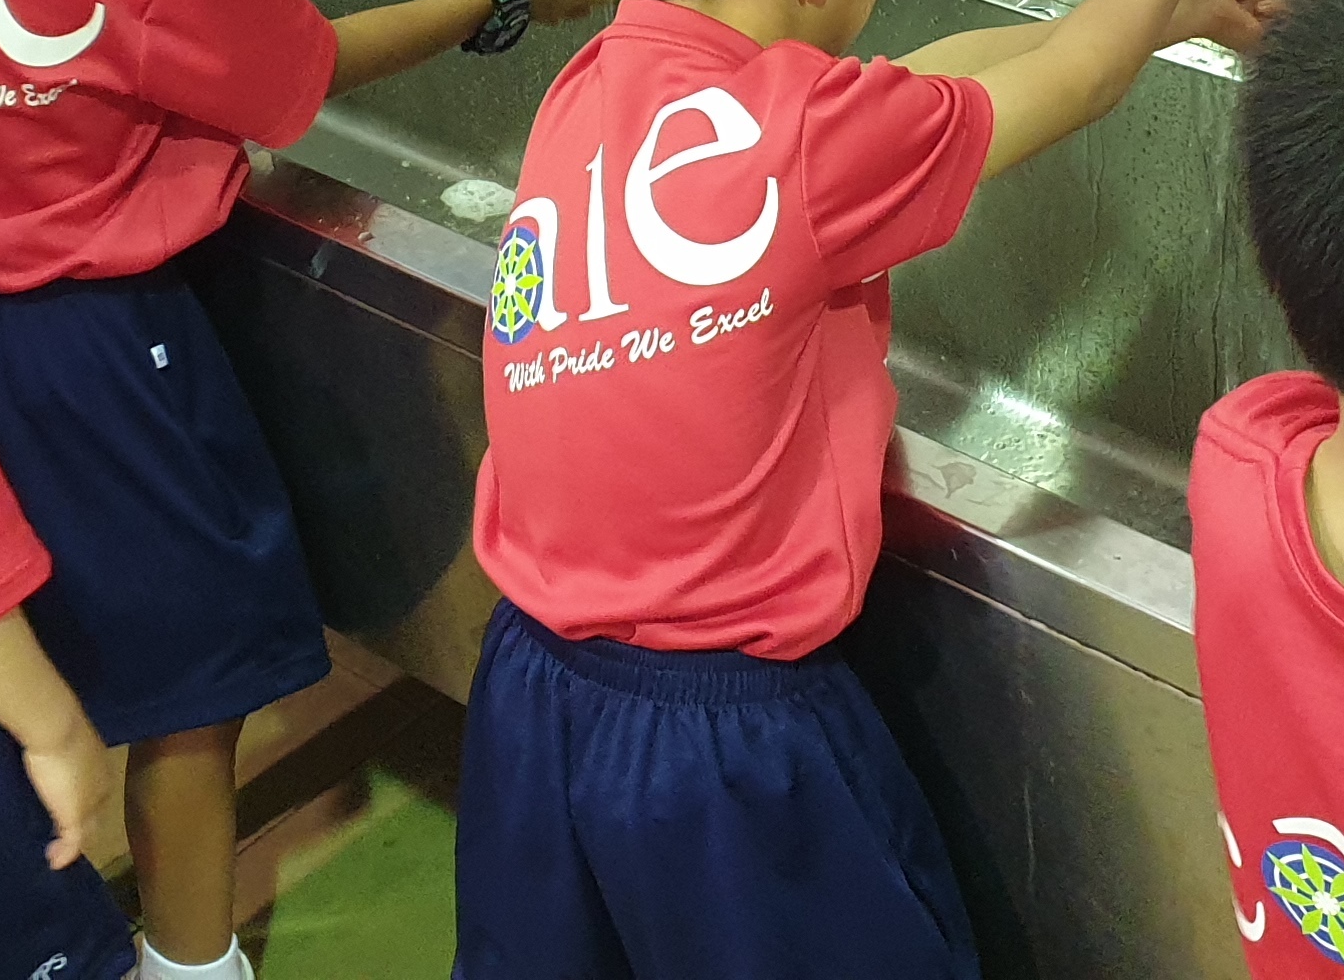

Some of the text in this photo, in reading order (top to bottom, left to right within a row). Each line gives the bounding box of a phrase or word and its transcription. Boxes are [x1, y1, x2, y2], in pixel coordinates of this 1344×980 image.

[504, 288, 774, 393] With Pride We Excel
